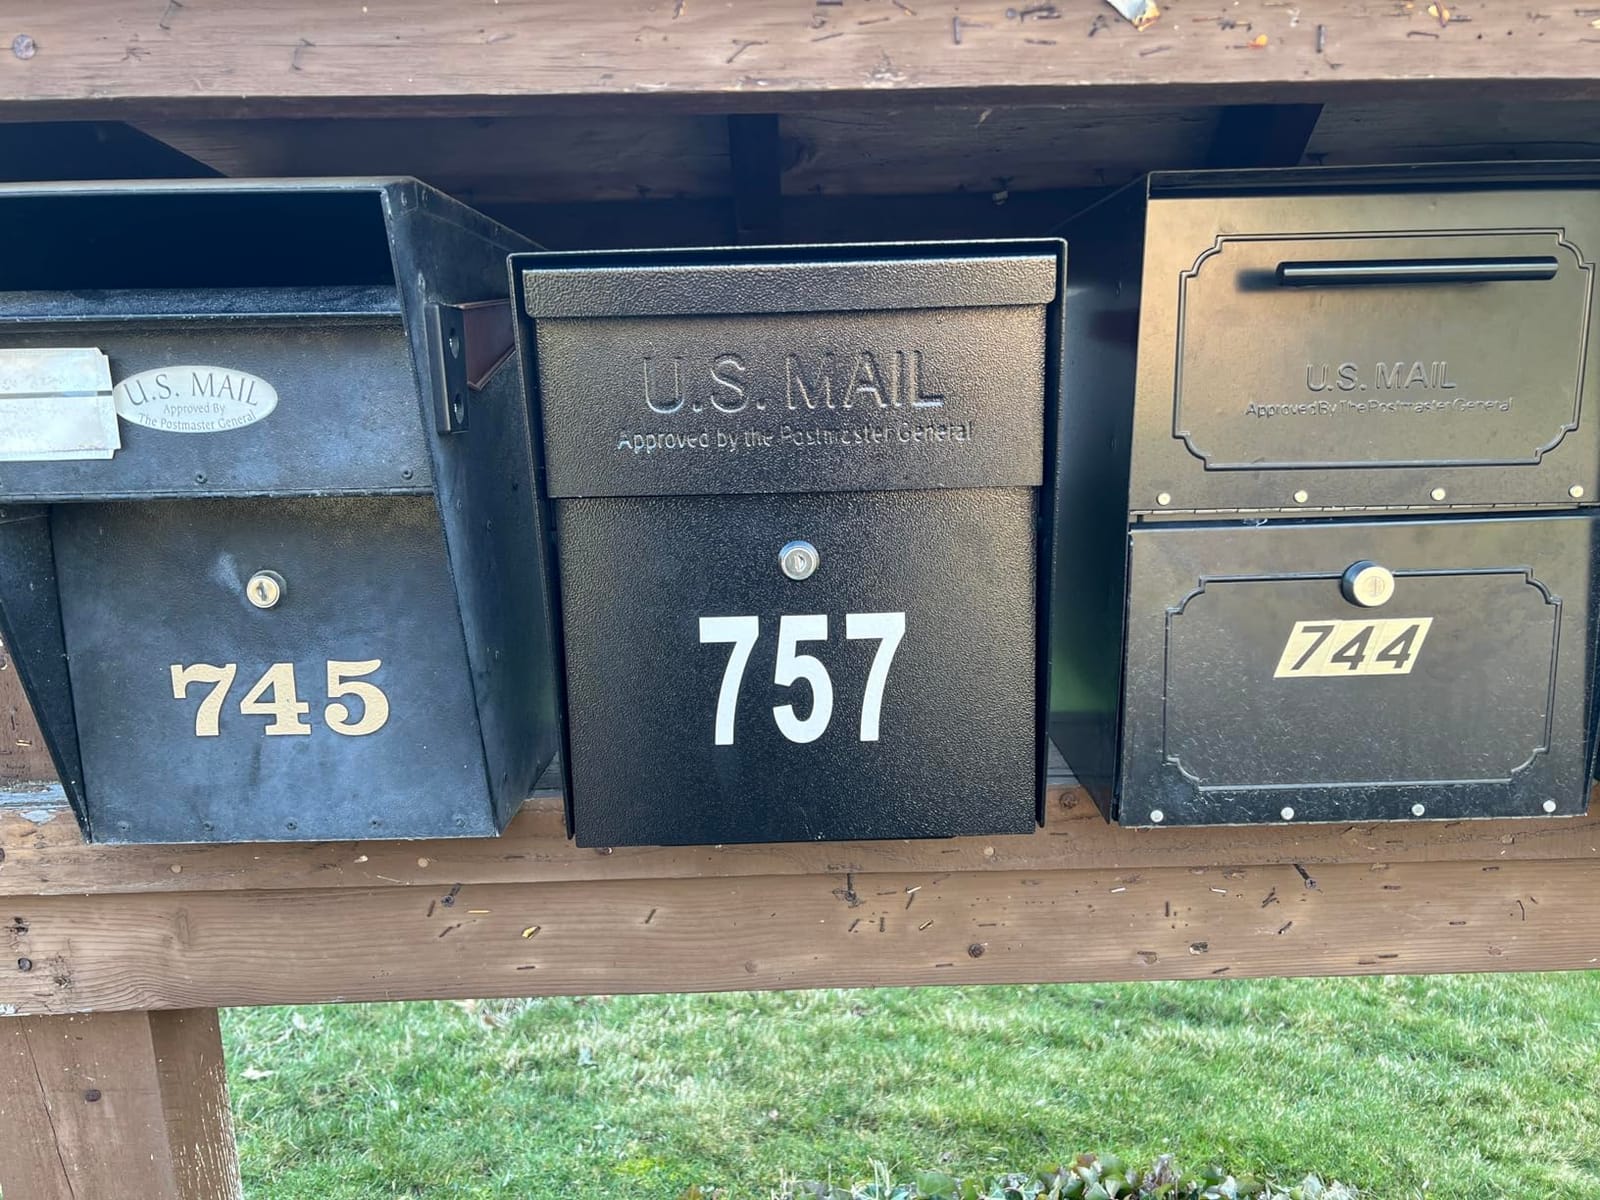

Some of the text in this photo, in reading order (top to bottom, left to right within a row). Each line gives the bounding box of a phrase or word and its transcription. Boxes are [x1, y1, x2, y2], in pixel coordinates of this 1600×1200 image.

[123, 371, 258, 406] U.S. MAIL
[642, 349, 946, 414] U.S. MAIL
[1305, 361, 1457, 392] U.S. MAIL
[138, 408, 257, 431] The Postmaster General
[163, 402, 226, 417] Approved By
[617, 420, 973, 454] Approved by the Postmaster General
[1289, 623, 1421, 671] 744
[698, 612, 906, 746] 757
[169, 658, 390, 737] 745
